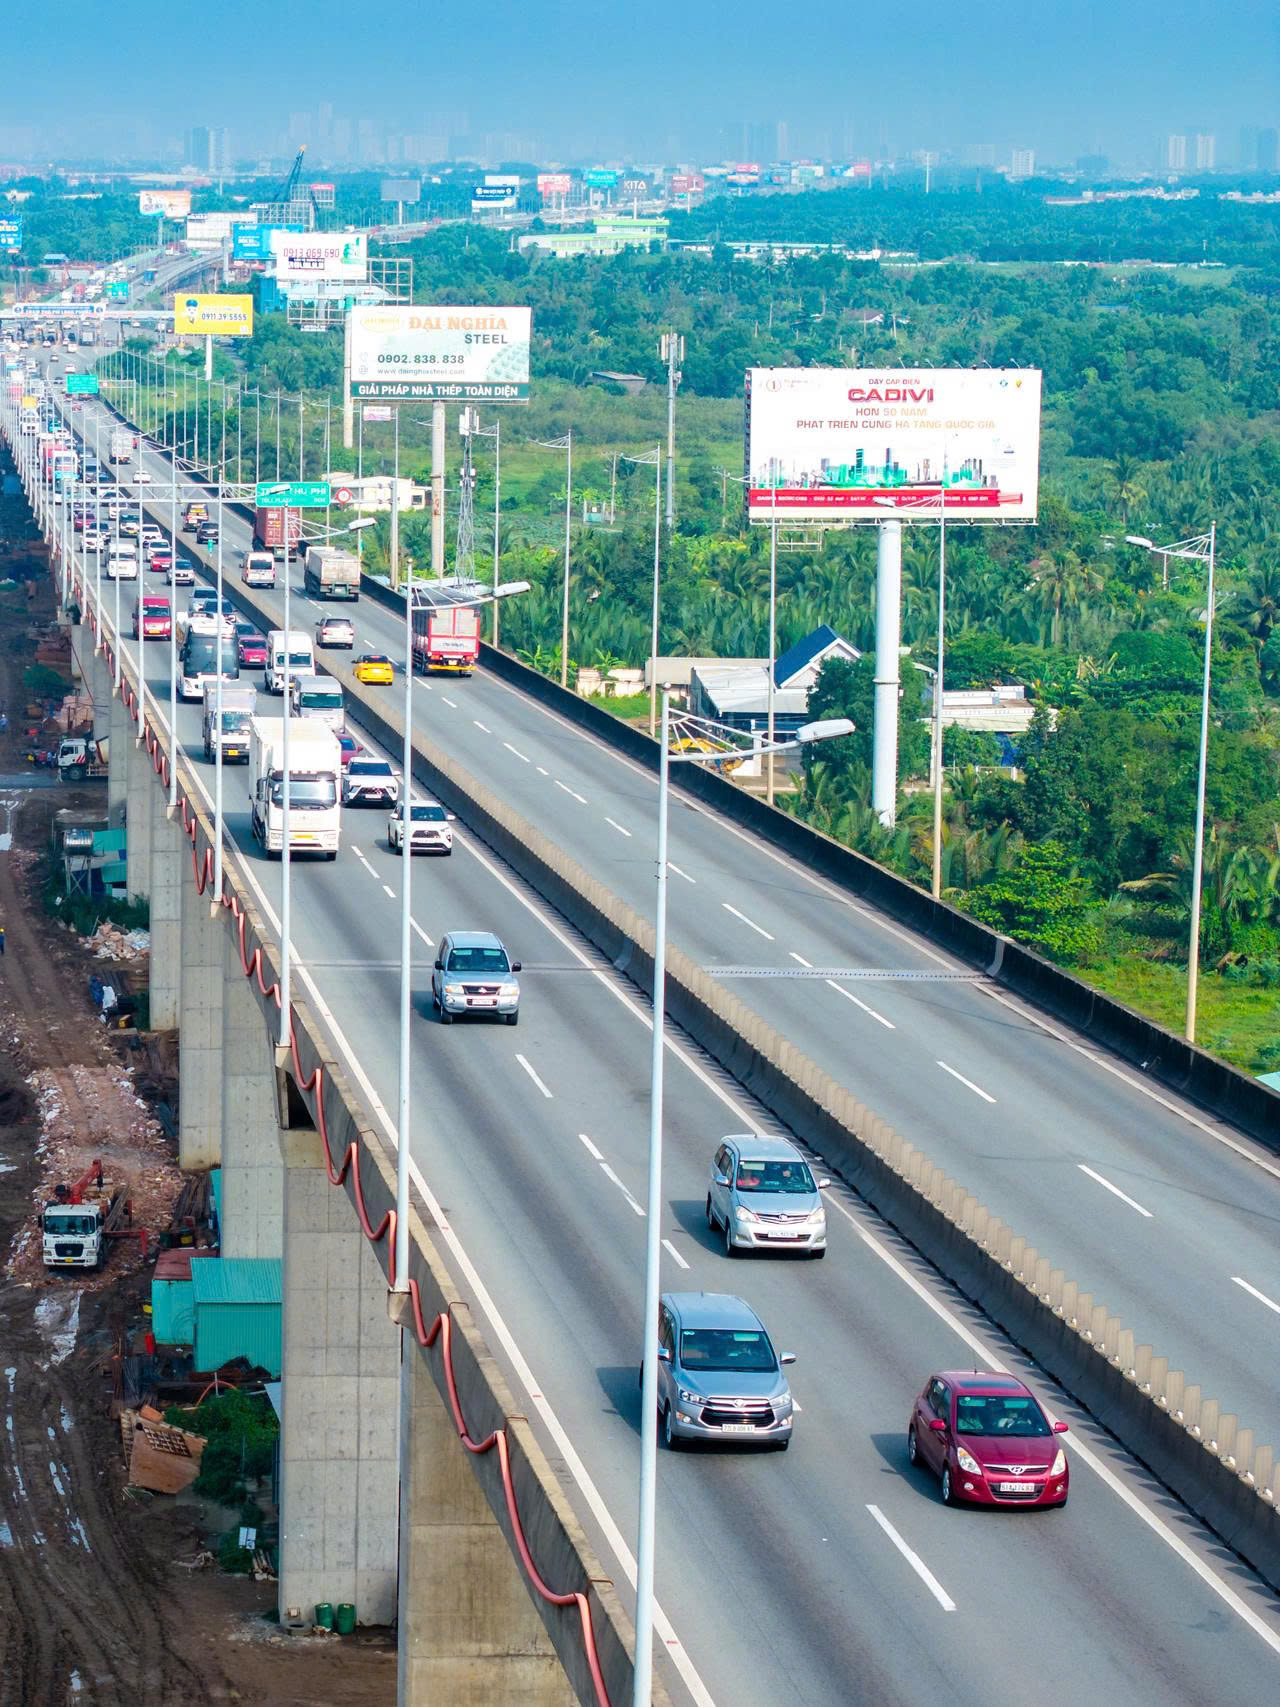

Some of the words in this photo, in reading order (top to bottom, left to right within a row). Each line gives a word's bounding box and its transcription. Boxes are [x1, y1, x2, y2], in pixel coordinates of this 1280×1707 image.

[464, 333, 509, 345] STEEL
[381, 383, 410, 395] PHÁP
[411, 384, 435, 396] NHÀ
[464, 385, 493, 396] TOÀN
[848, 388, 935, 403] CADIVI
